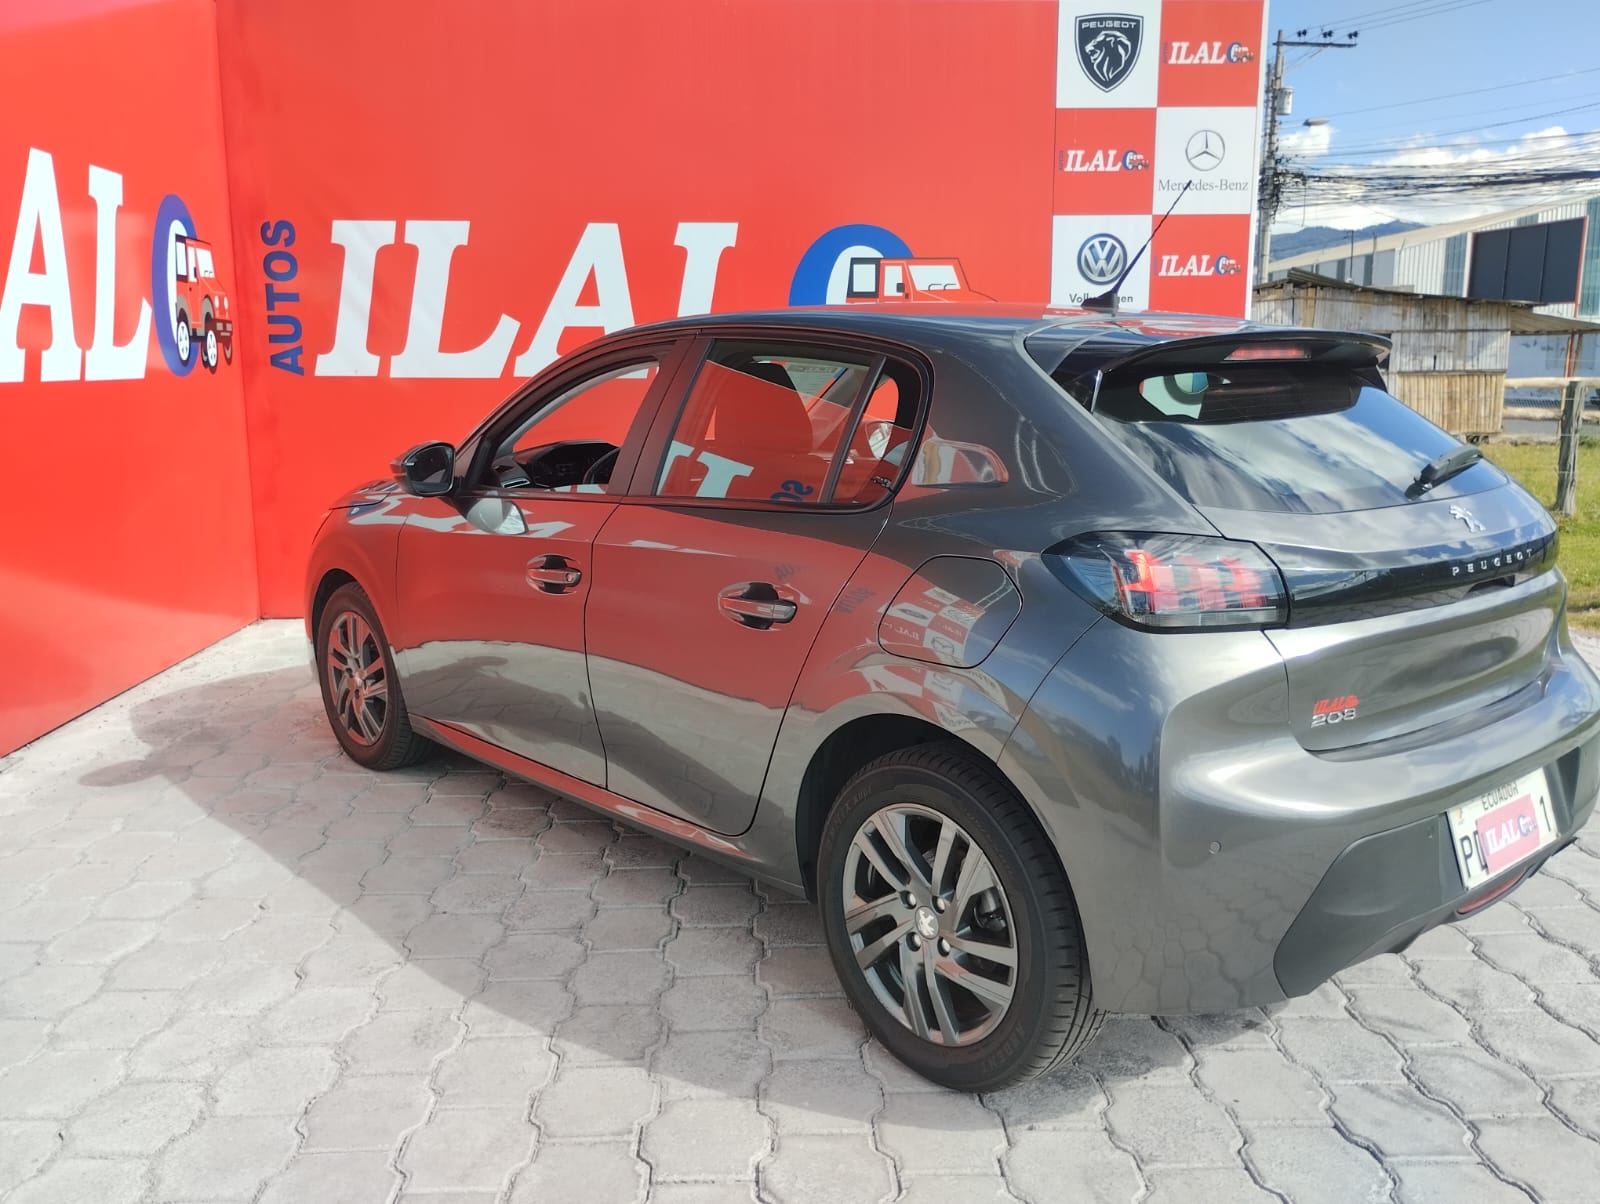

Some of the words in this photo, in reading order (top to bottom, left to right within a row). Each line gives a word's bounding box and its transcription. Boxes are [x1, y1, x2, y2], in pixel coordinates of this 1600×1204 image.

[1081, 20, 1137, 29] PEUGEOT
[260, 219, 305, 376] AUTOS
[1069, 293, 1134, 304] Volen
[1452, 549, 1533, 576] PEUGEOT
[1310, 707, 1357, 728] 208
[1481, 780, 1519, 811] ECUADOR
